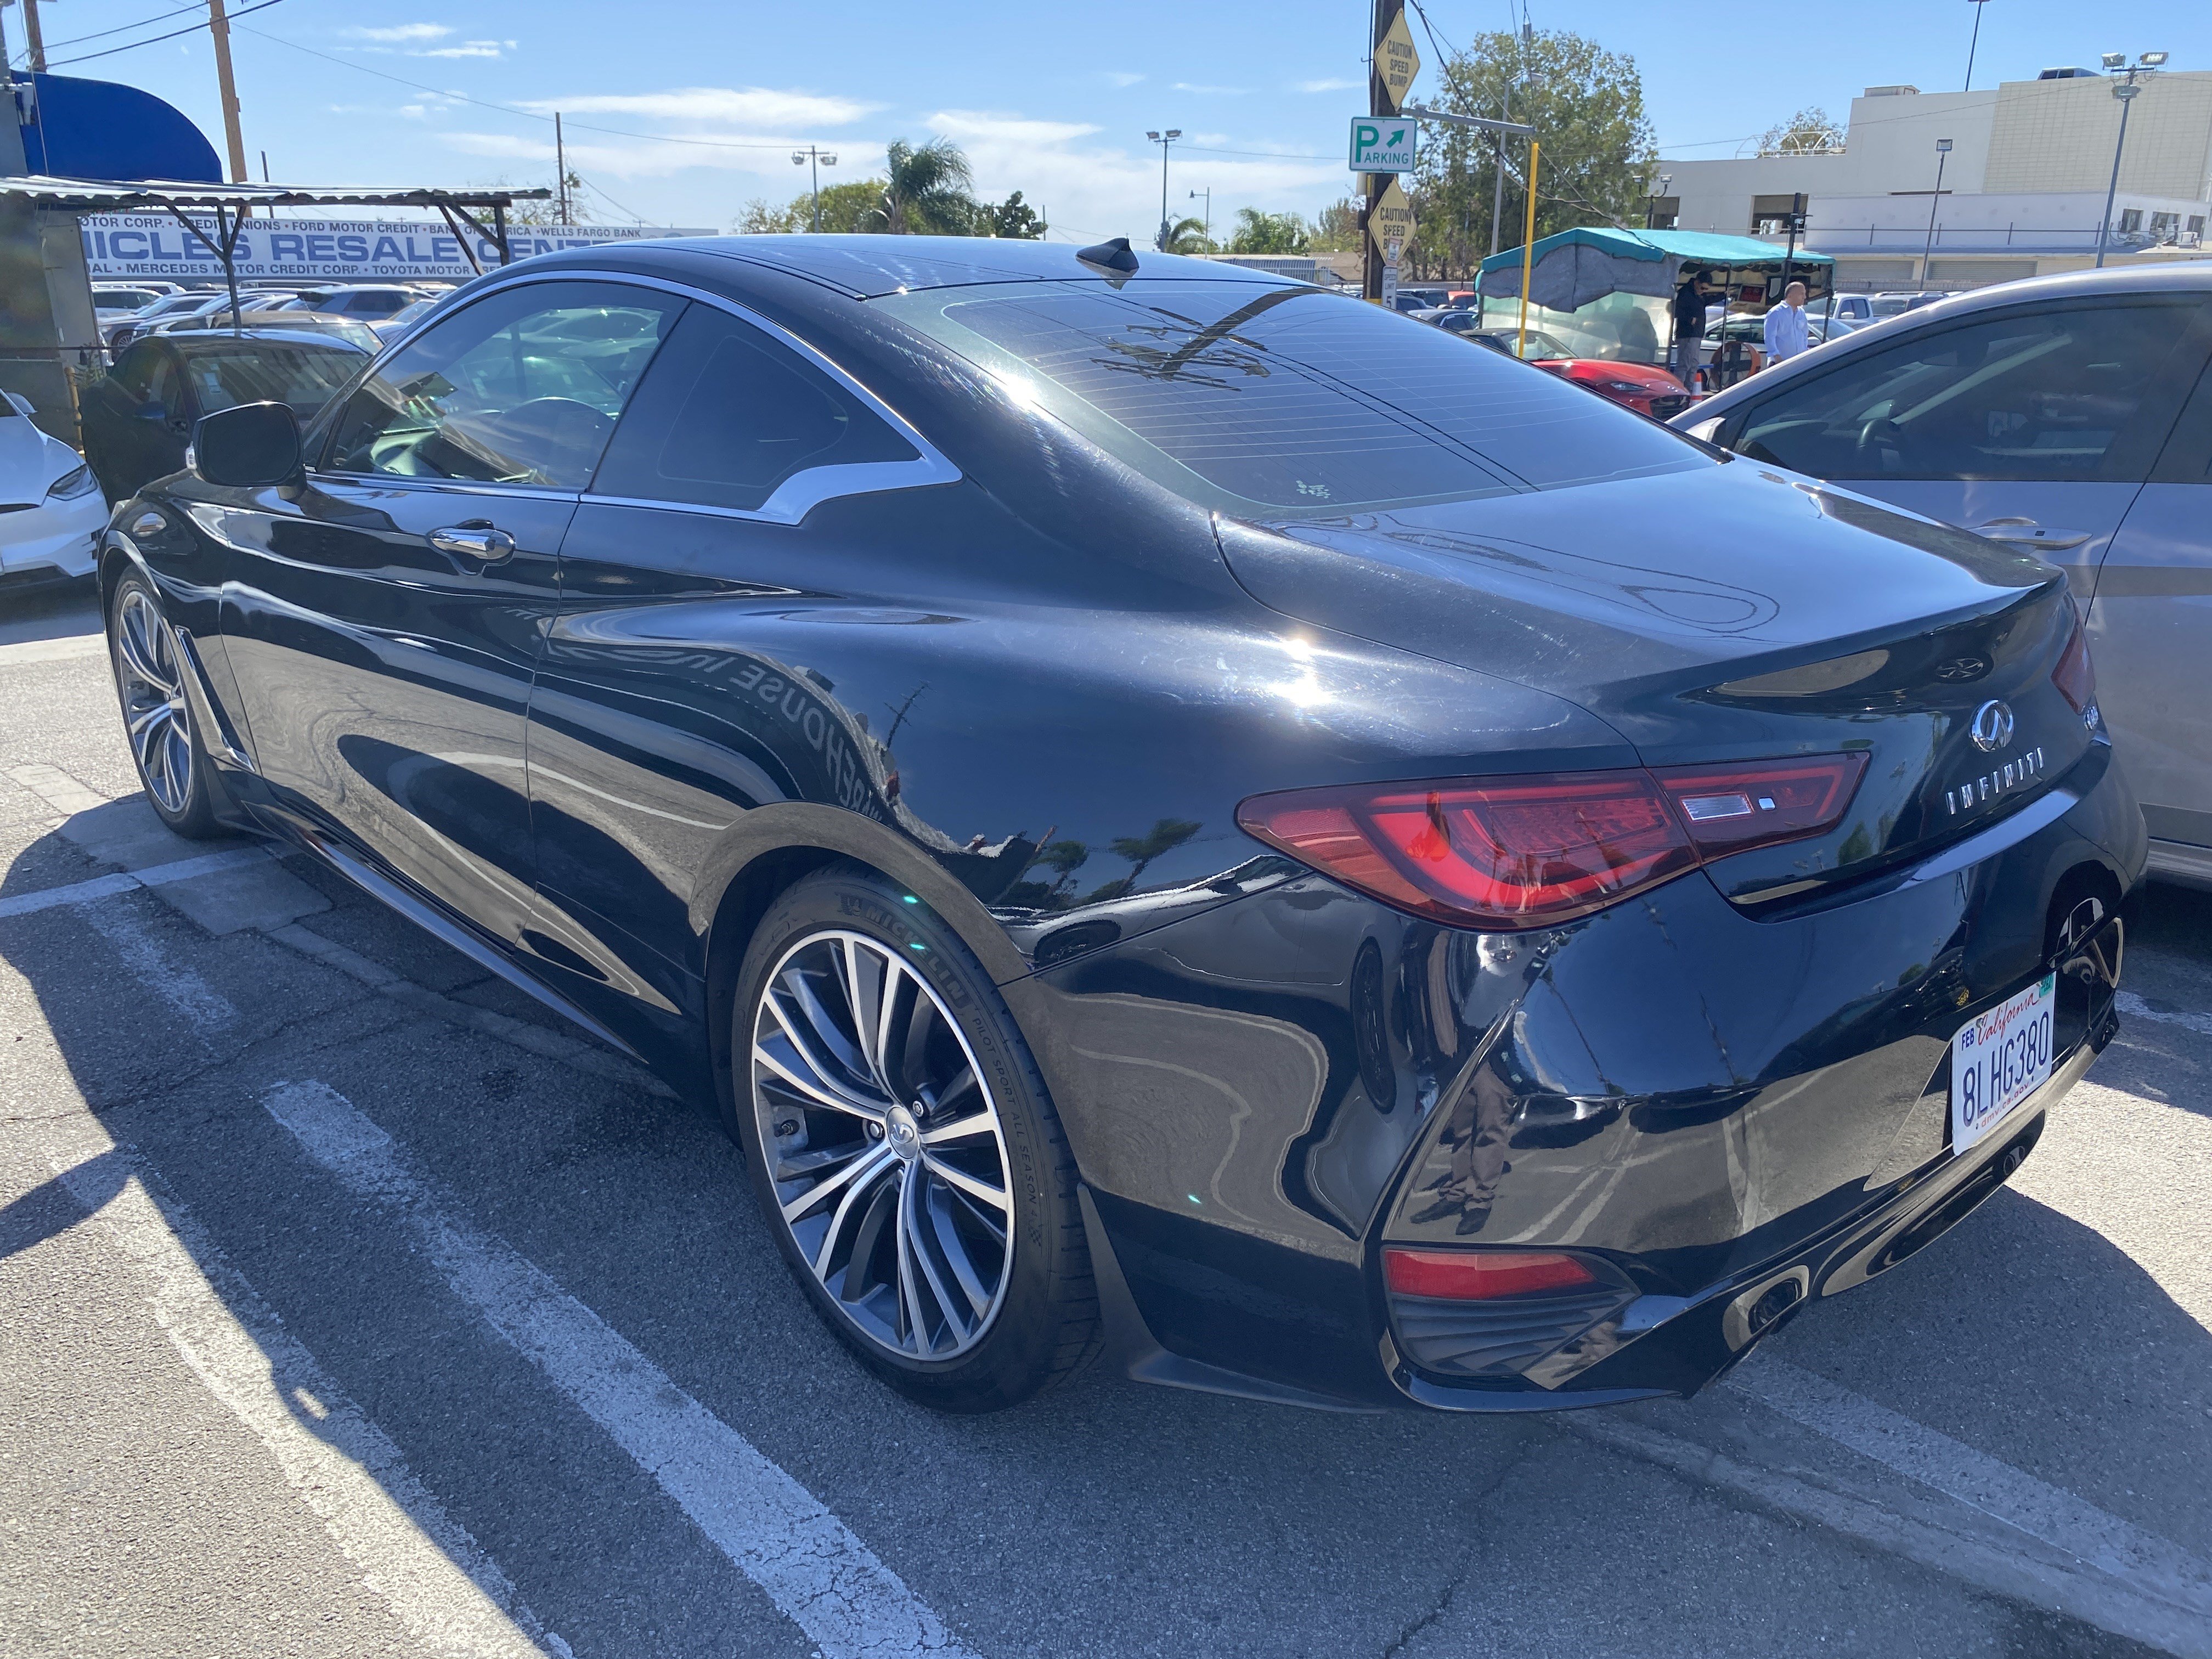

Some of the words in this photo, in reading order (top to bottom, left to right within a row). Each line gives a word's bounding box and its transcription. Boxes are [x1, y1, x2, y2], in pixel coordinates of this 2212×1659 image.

[1387, 40, 1412, 59] CAUTION
[1390, 59, 1409, 74] SPEED
[1389, 74, 1408, 87] BUMP
[1380, 207, 1411, 223] CAUTION
[80, 217, 119, 227] OTOR
[124, 218, 164, 228] CORP.
[292, 222, 325, 231] FORD
[330, 223, 373, 233] MOTOR
[377, 224, 419, 234] CREDIT
[430, 225, 459, 234] BAN
[540, 228, 574, 236] WELLS
[577, 228, 610, 237] FARGO
[614, 229, 641, 238] BANK
[1383, 224, 1405, 236] SPEED
[270, 234, 460, 262] RESALE
[1383, 238, 1403, 249] BP
[126, 263, 208, 273] MERCEDES
[270, 264, 318, 274] CREDIT
[323, 265, 360, 274] CORP.
[373, 266, 422, 275] TOYOTA
[426, 266, 469, 274] MOTOR
[1946, 747, 2043, 815] INFINITI
[865, 906, 966, 1002] MICHELIN
[1961, 1027, 1974, 1051] FEB
[1978, 992, 2040, 1046] California
[1963, 1011, 2049, 1127] 8LHG380
[973, 1018, 996, 1053] PILOT
[993, 1059, 1015, 1104] SPORT
[1011, 1112, 1025, 1137] ALL
[1019, 1145, 1036, 1204] SEASON
[1981, 1082, 2029, 1128] dmv.ca.gov
